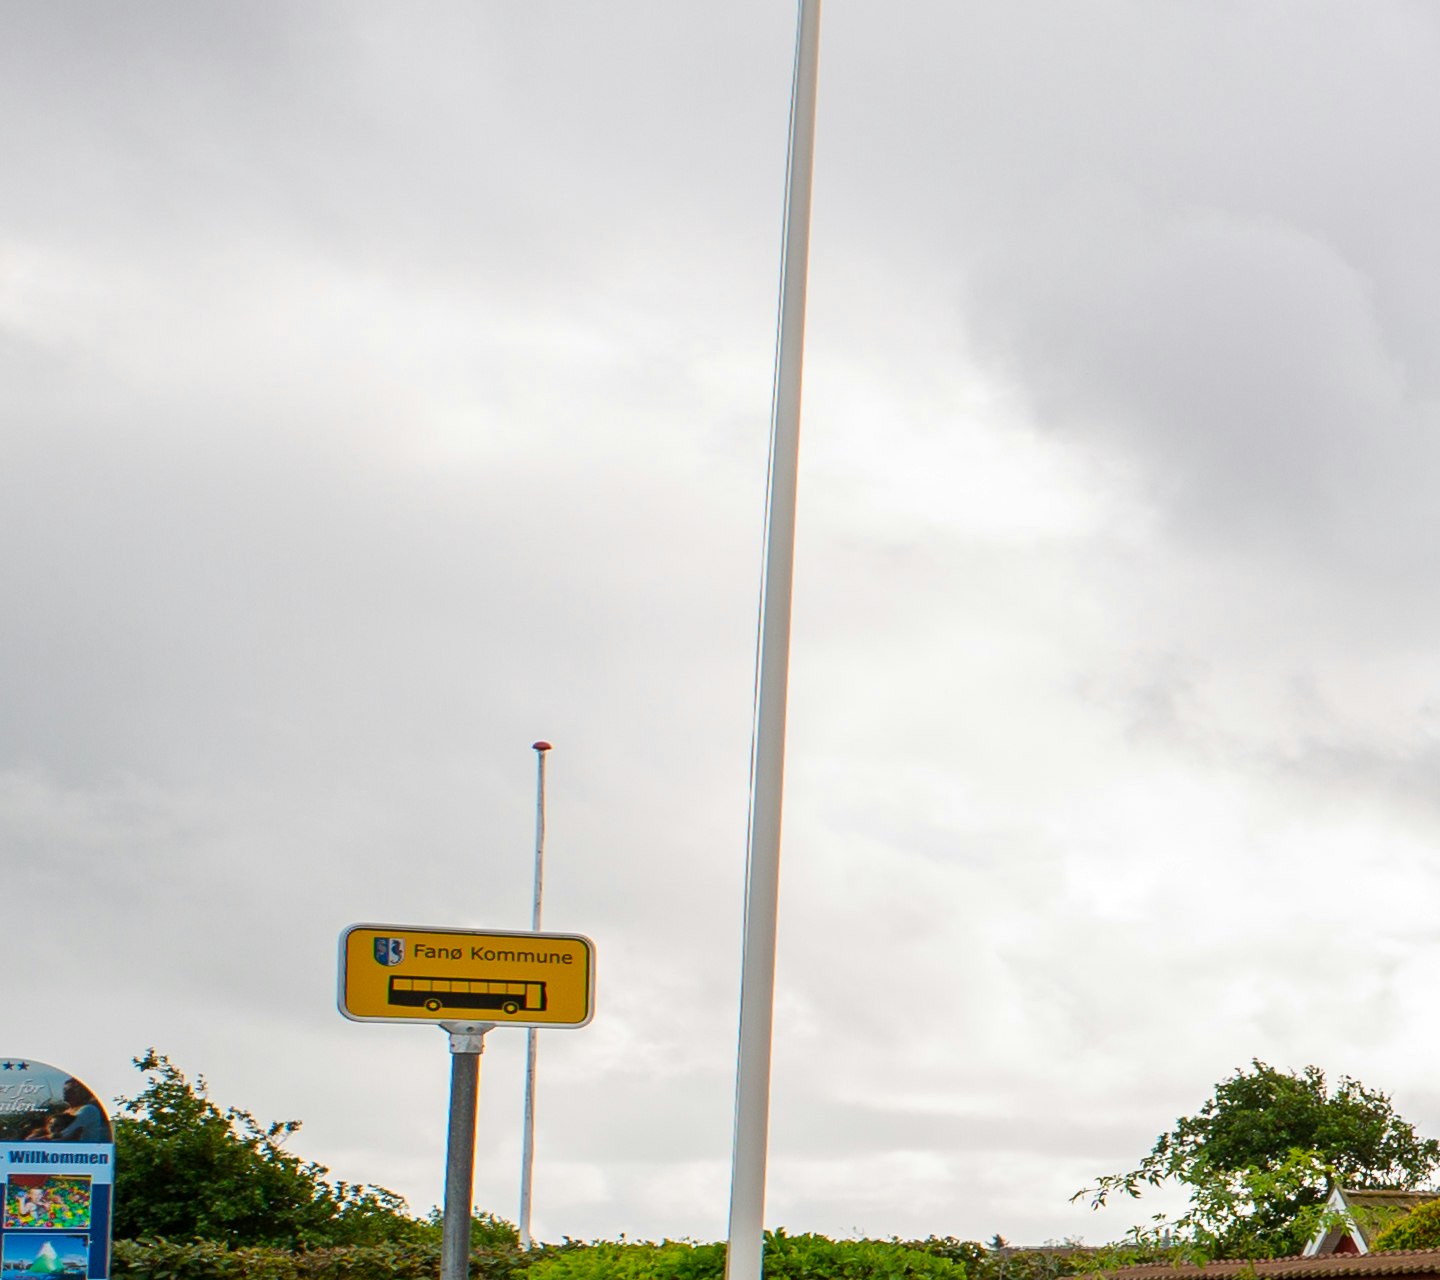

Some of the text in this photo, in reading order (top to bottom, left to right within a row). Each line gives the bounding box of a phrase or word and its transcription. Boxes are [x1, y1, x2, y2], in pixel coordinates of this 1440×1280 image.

[414, 944, 573, 964] Fanø Kommune
[8, 1150, 109, 1165] Willkommen
